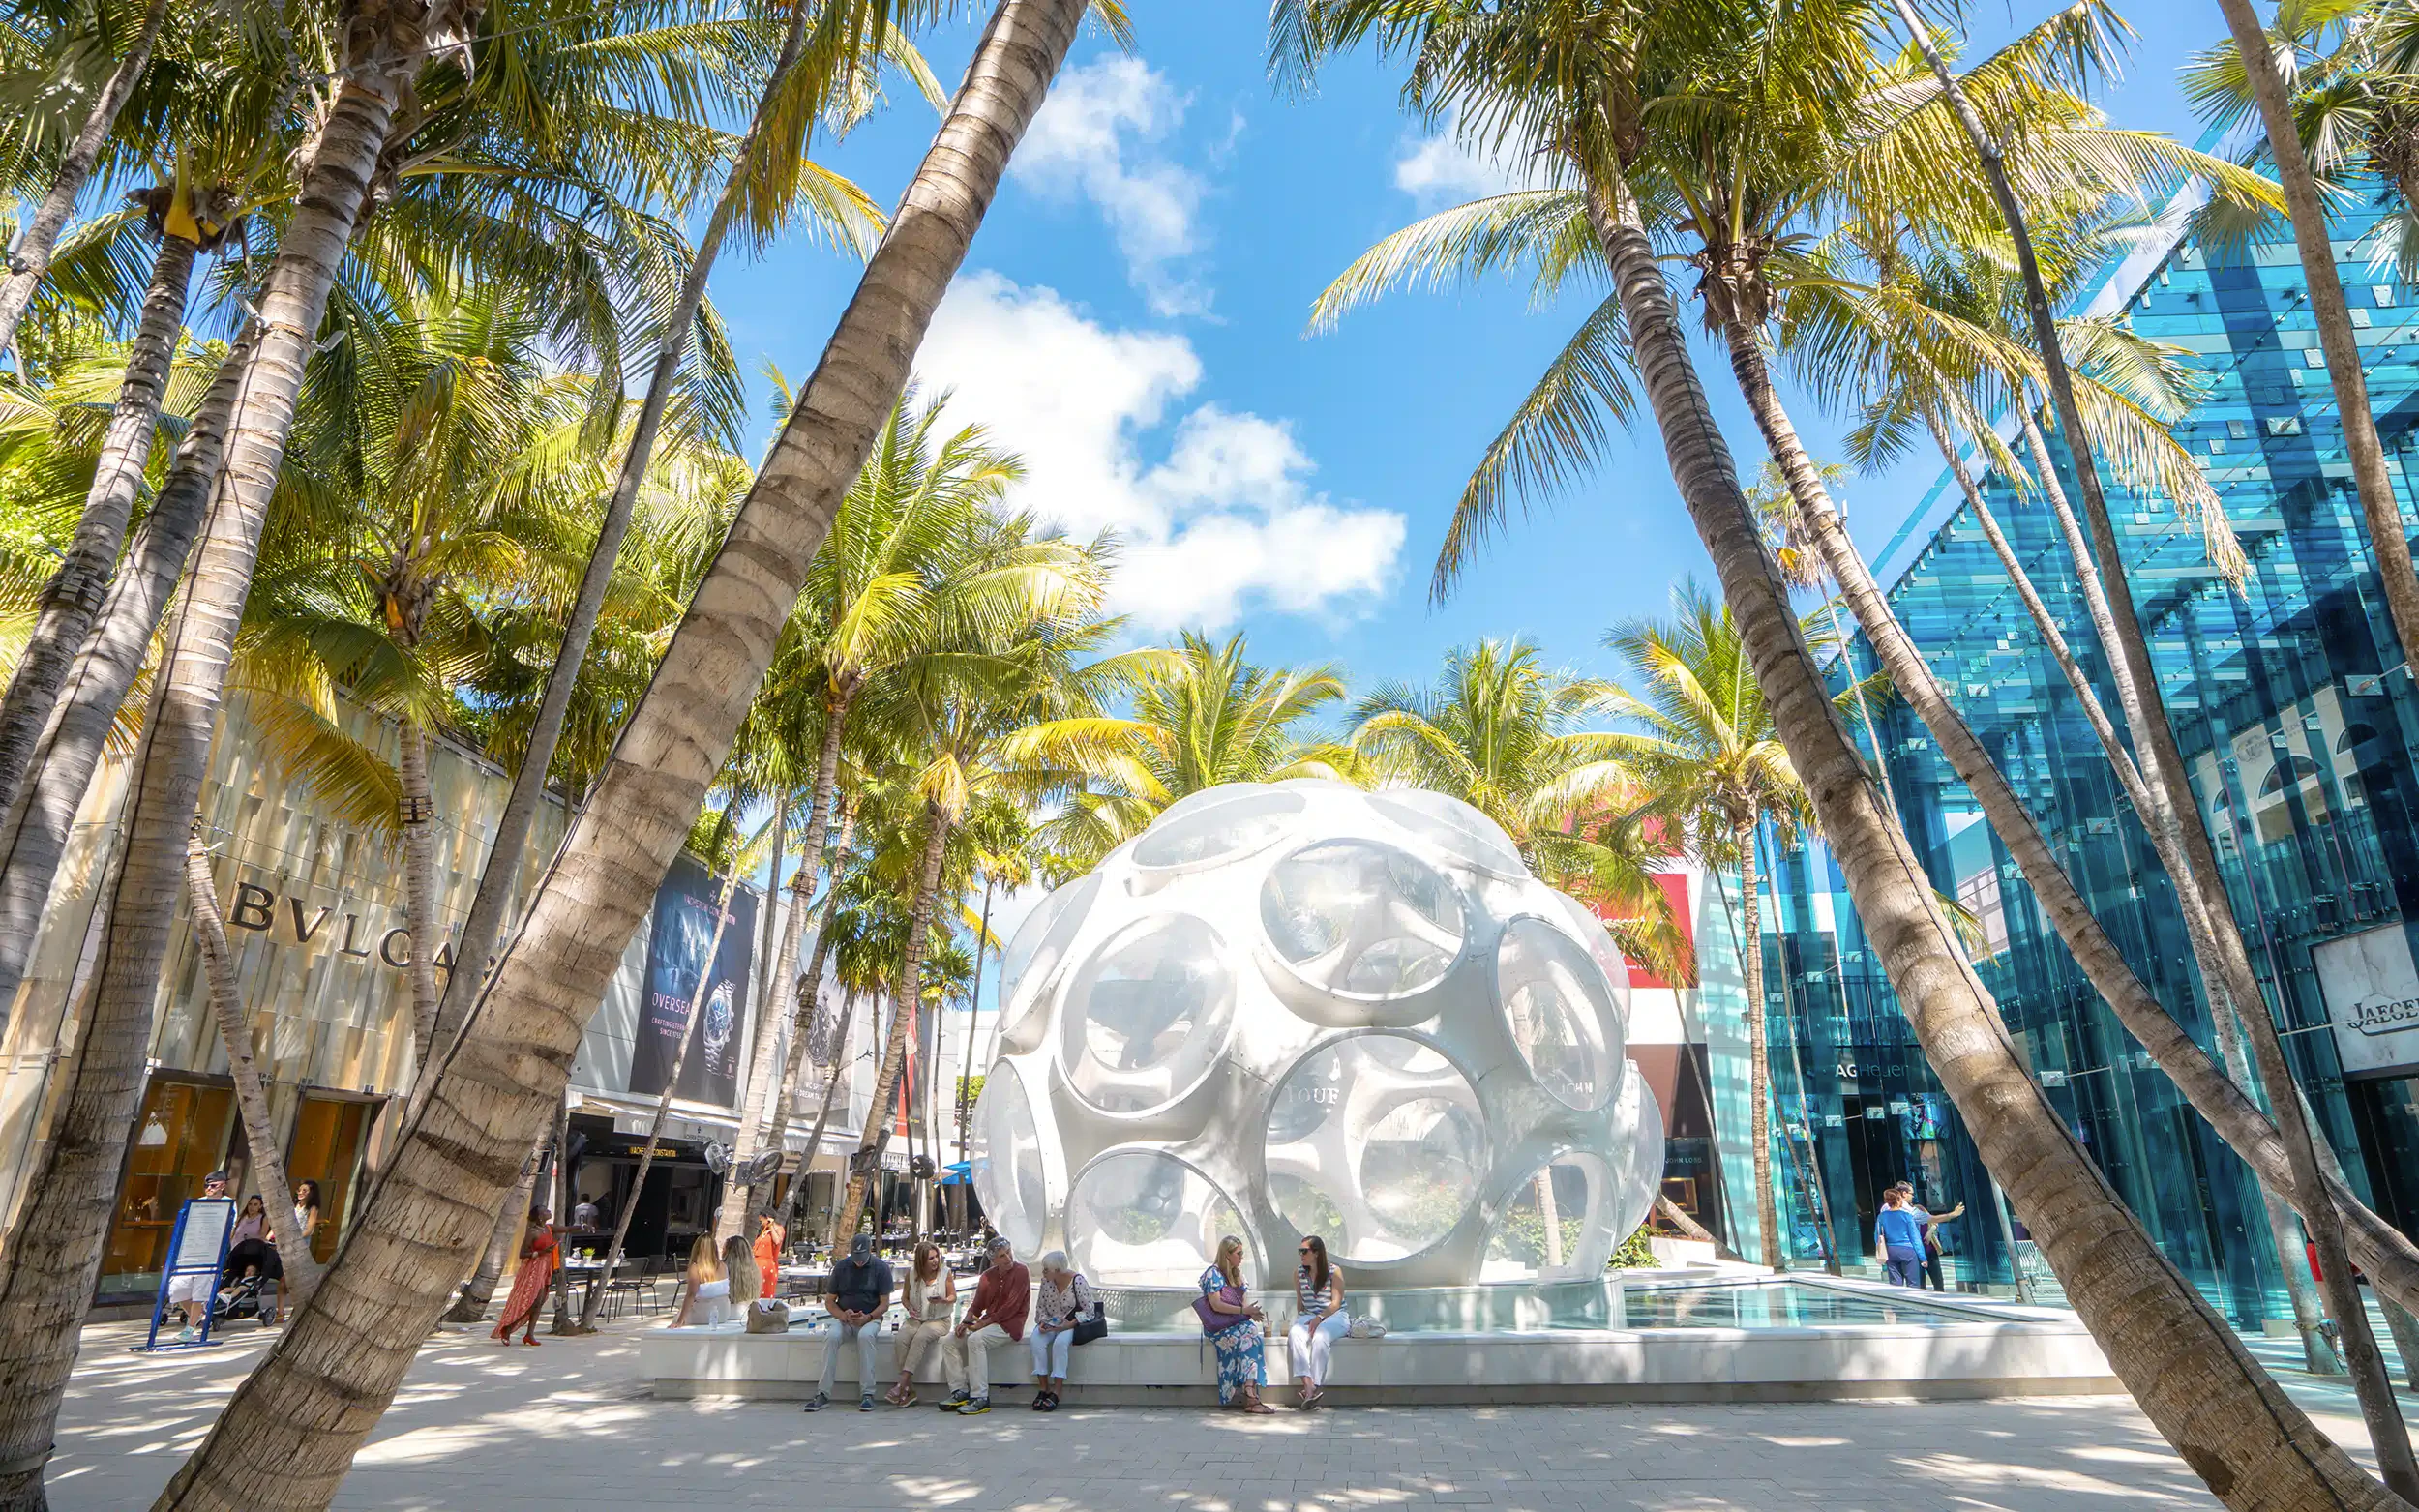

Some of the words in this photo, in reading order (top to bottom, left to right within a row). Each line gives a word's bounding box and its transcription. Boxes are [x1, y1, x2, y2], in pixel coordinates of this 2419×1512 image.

[226, 880, 496, 980] BVLGA
[652, 992, 692, 1016] OVERSEA
[2346, 997, 2419, 1029] JAEGE
[651, 1017, 672, 1028] CRAFTING
[672, 1023, 686, 1031] ETERN
[659, 1027, 672, 1038] SINCE
